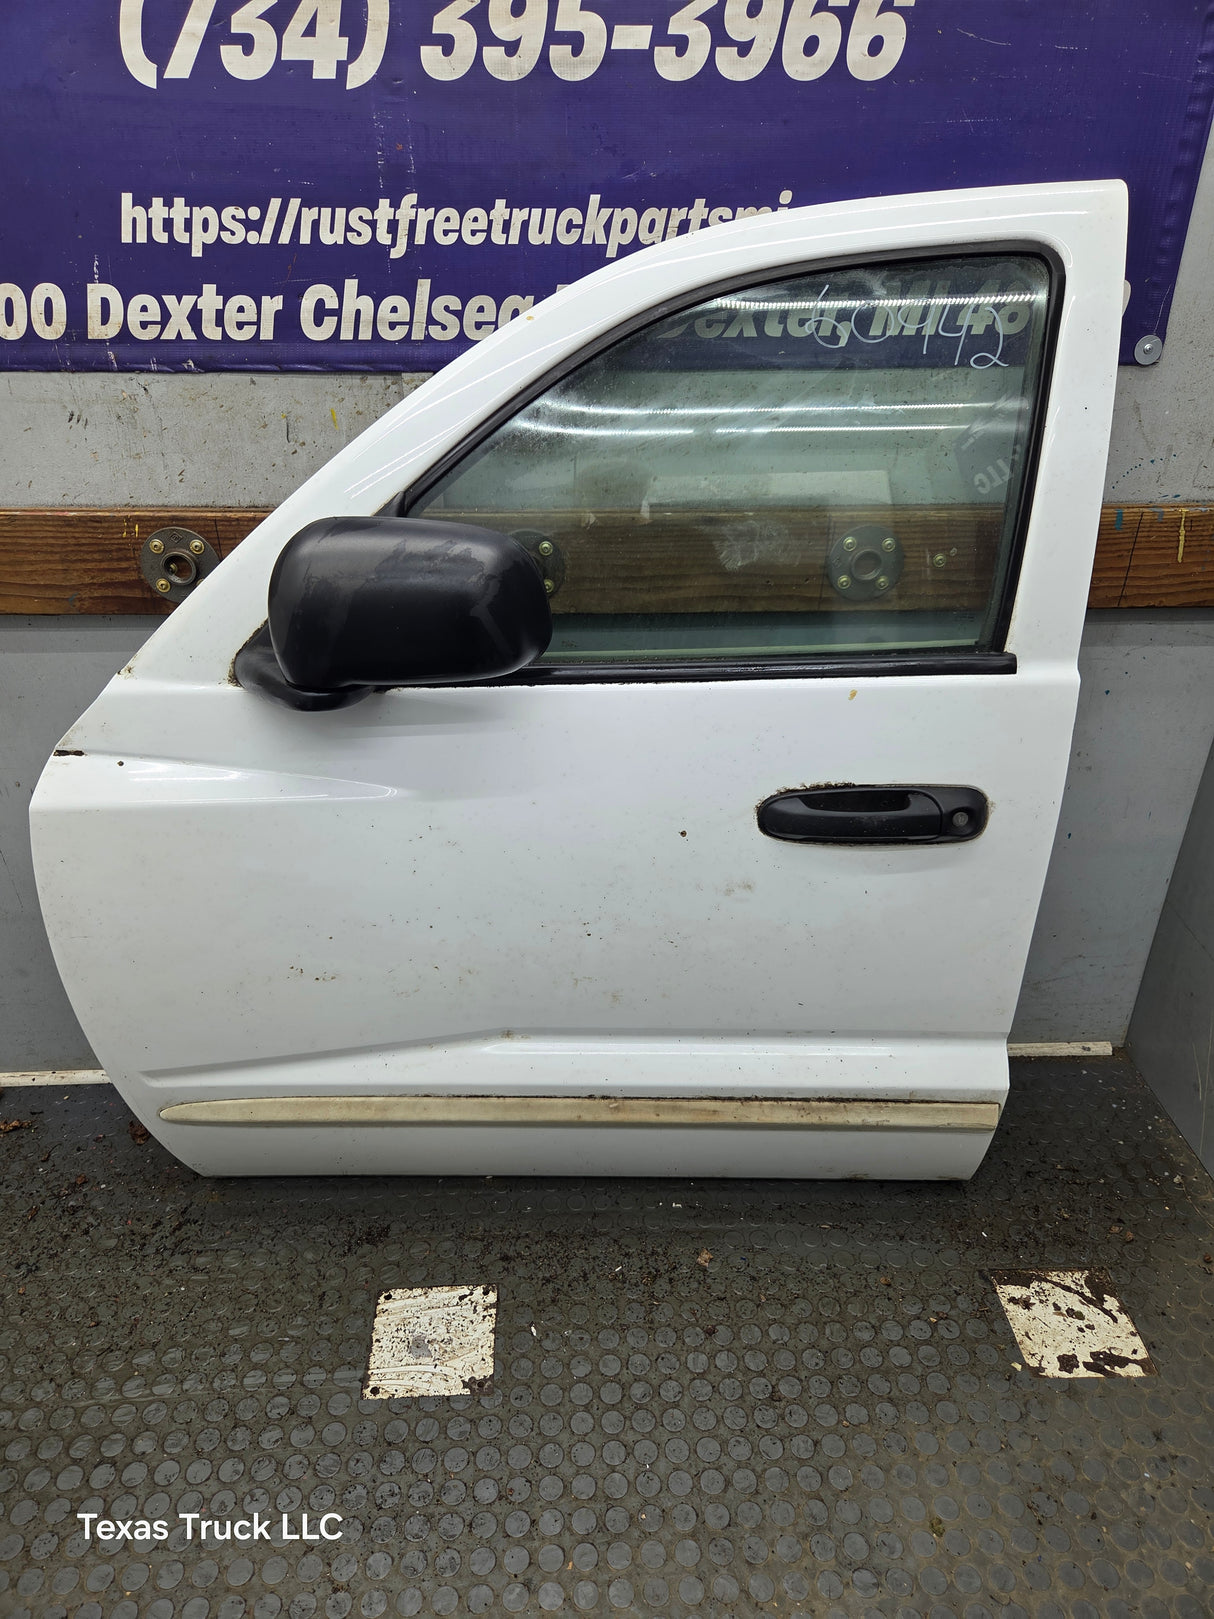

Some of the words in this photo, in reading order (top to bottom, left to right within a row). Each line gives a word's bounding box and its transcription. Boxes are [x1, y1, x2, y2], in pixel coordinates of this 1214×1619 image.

[120, 0, 390, 90] (734)
[420, 0, 915, 81] 395-3966
[121, 190, 793, 258] https://rustfreetruckparts
[87, 283, 284, 341] Dexter
[656, 290, 852, 347] exter,
